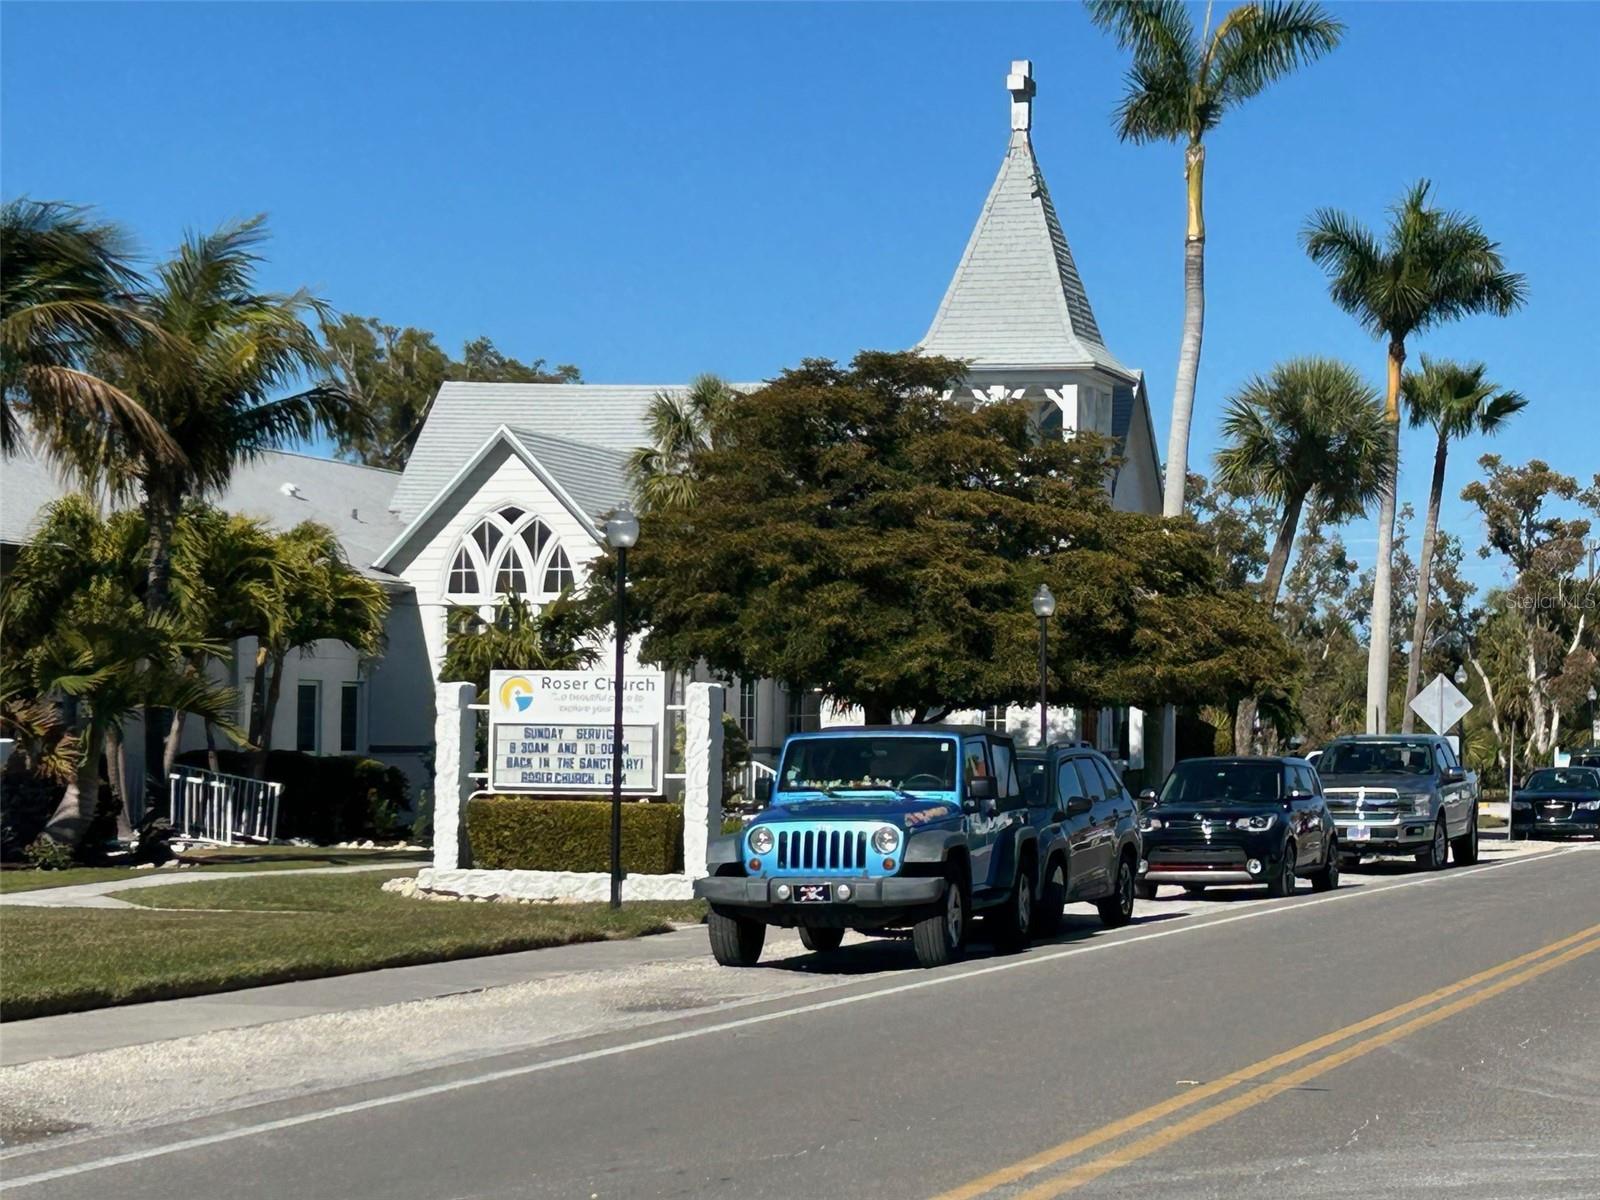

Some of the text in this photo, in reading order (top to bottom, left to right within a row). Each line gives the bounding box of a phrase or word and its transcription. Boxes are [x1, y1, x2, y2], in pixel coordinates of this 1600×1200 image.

[541, 677, 589, 690] Roser
[524, 727, 614, 740] SUNDAY SERVIC
[557, 742, 577, 754] AND
[585, 743, 629, 755] 10:00M
[506, 756, 644, 770] BACK IN THE SANCTARY!
